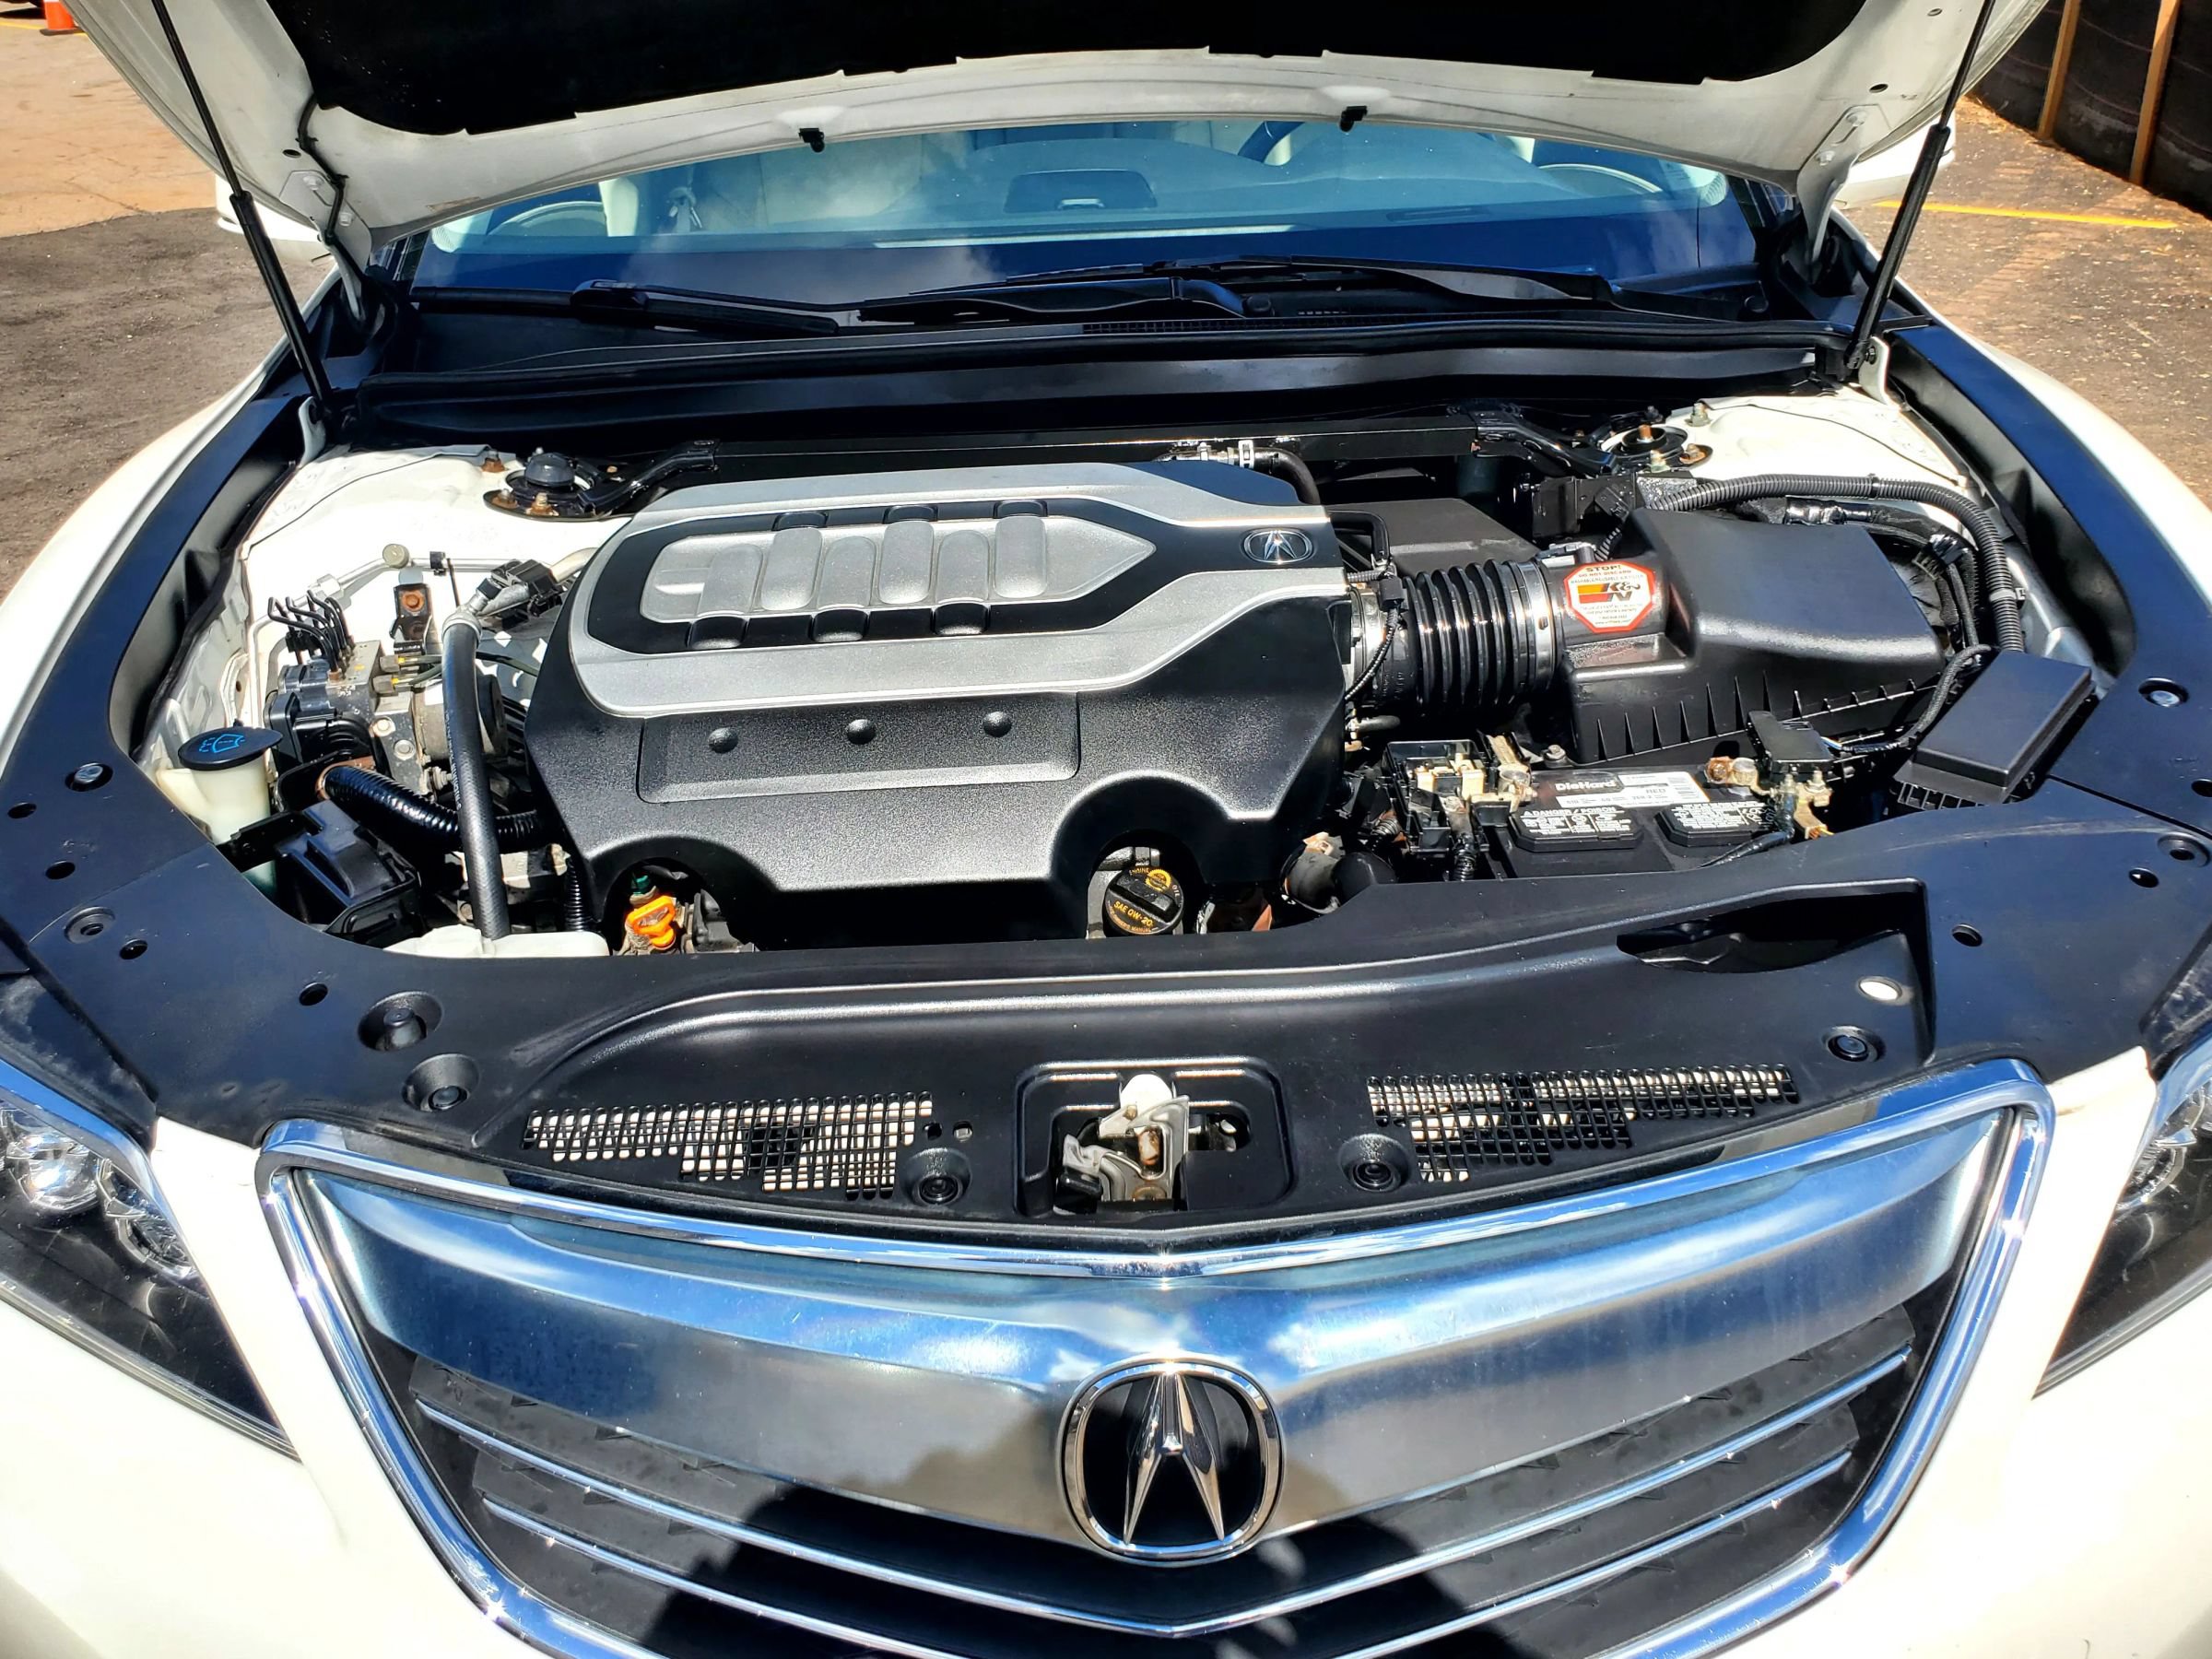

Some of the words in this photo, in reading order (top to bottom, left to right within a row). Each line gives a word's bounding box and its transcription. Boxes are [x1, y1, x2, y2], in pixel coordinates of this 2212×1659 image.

[1585, 564, 1621, 572] STOP!
[1555, 780, 1617, 791] DieHard
[1113, 900, 1129, 912] SAE
